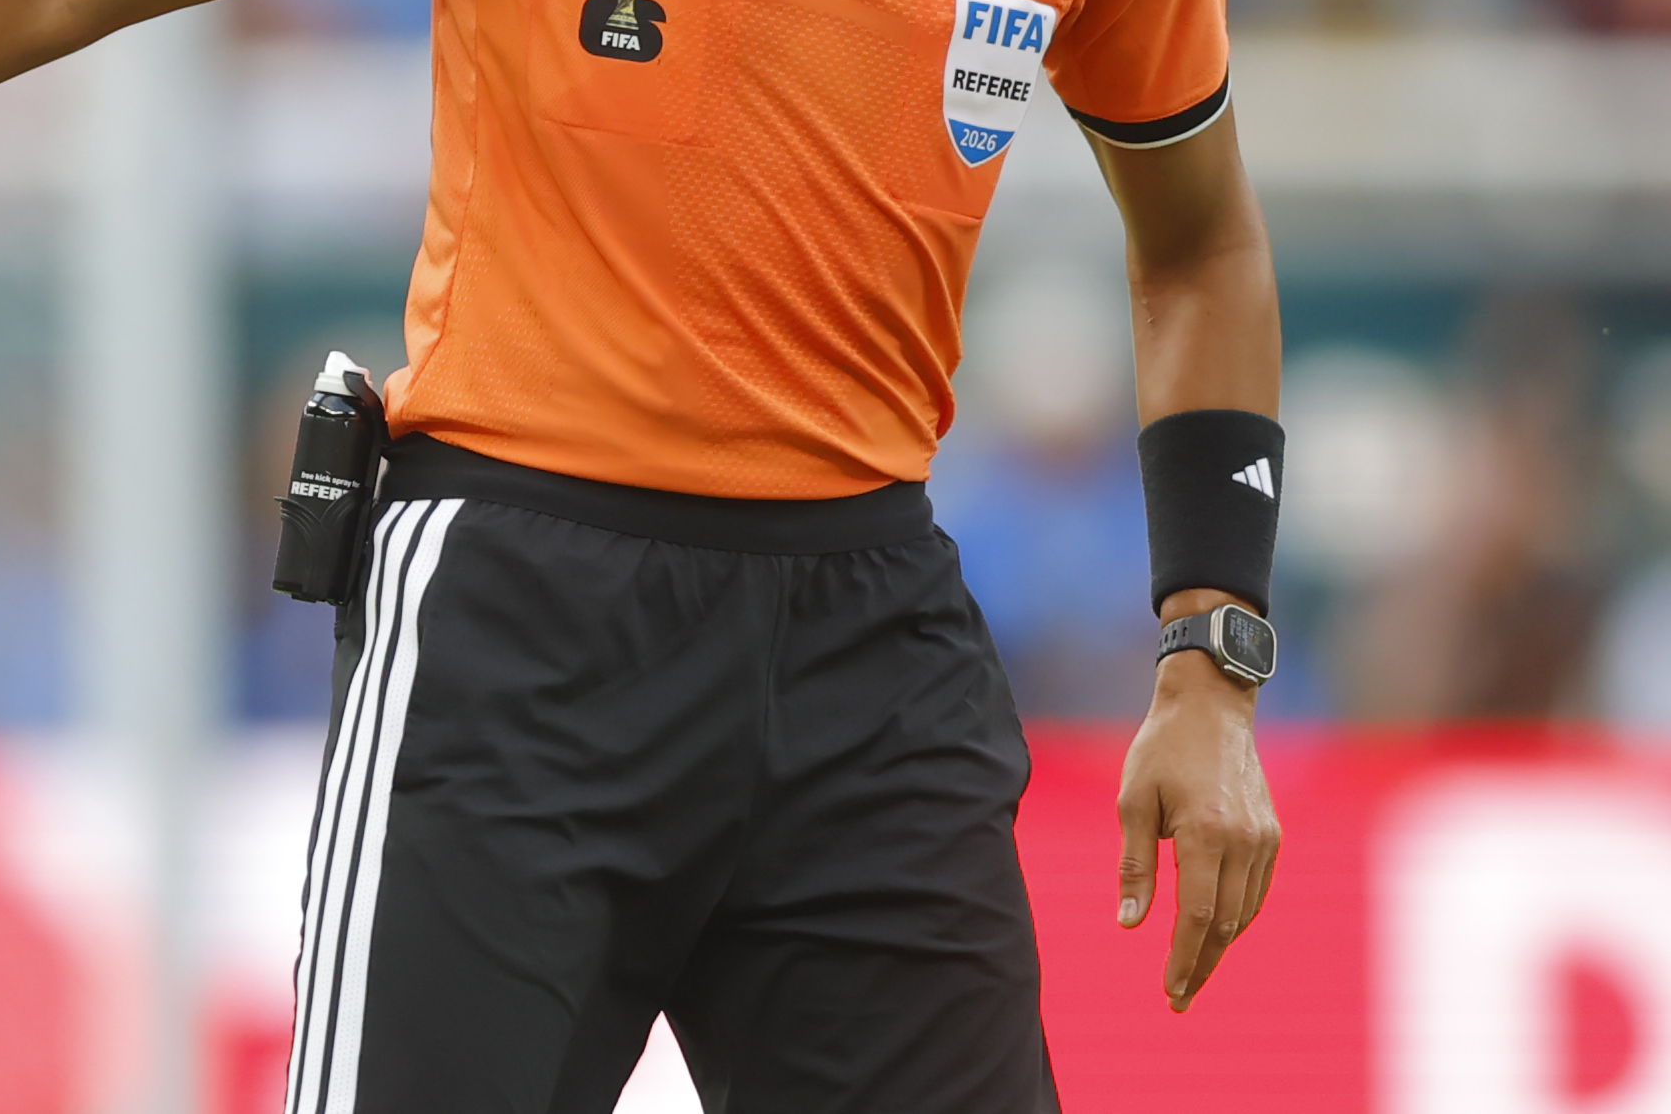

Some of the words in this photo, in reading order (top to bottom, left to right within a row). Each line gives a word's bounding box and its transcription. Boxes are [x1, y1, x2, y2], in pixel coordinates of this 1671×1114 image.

[963, 1, 1044, 53] FIFA
[601, 31, 641, 51] FIFA
[952, 69, 1031, 102] REFEREE
[960, 128, 998, 152] 2026
[301, 471, 314, 480] free
[315, 473, 331, 483] kick
[332, 478, 351, 488] spray
[291, 481, 349, 501] REFER
